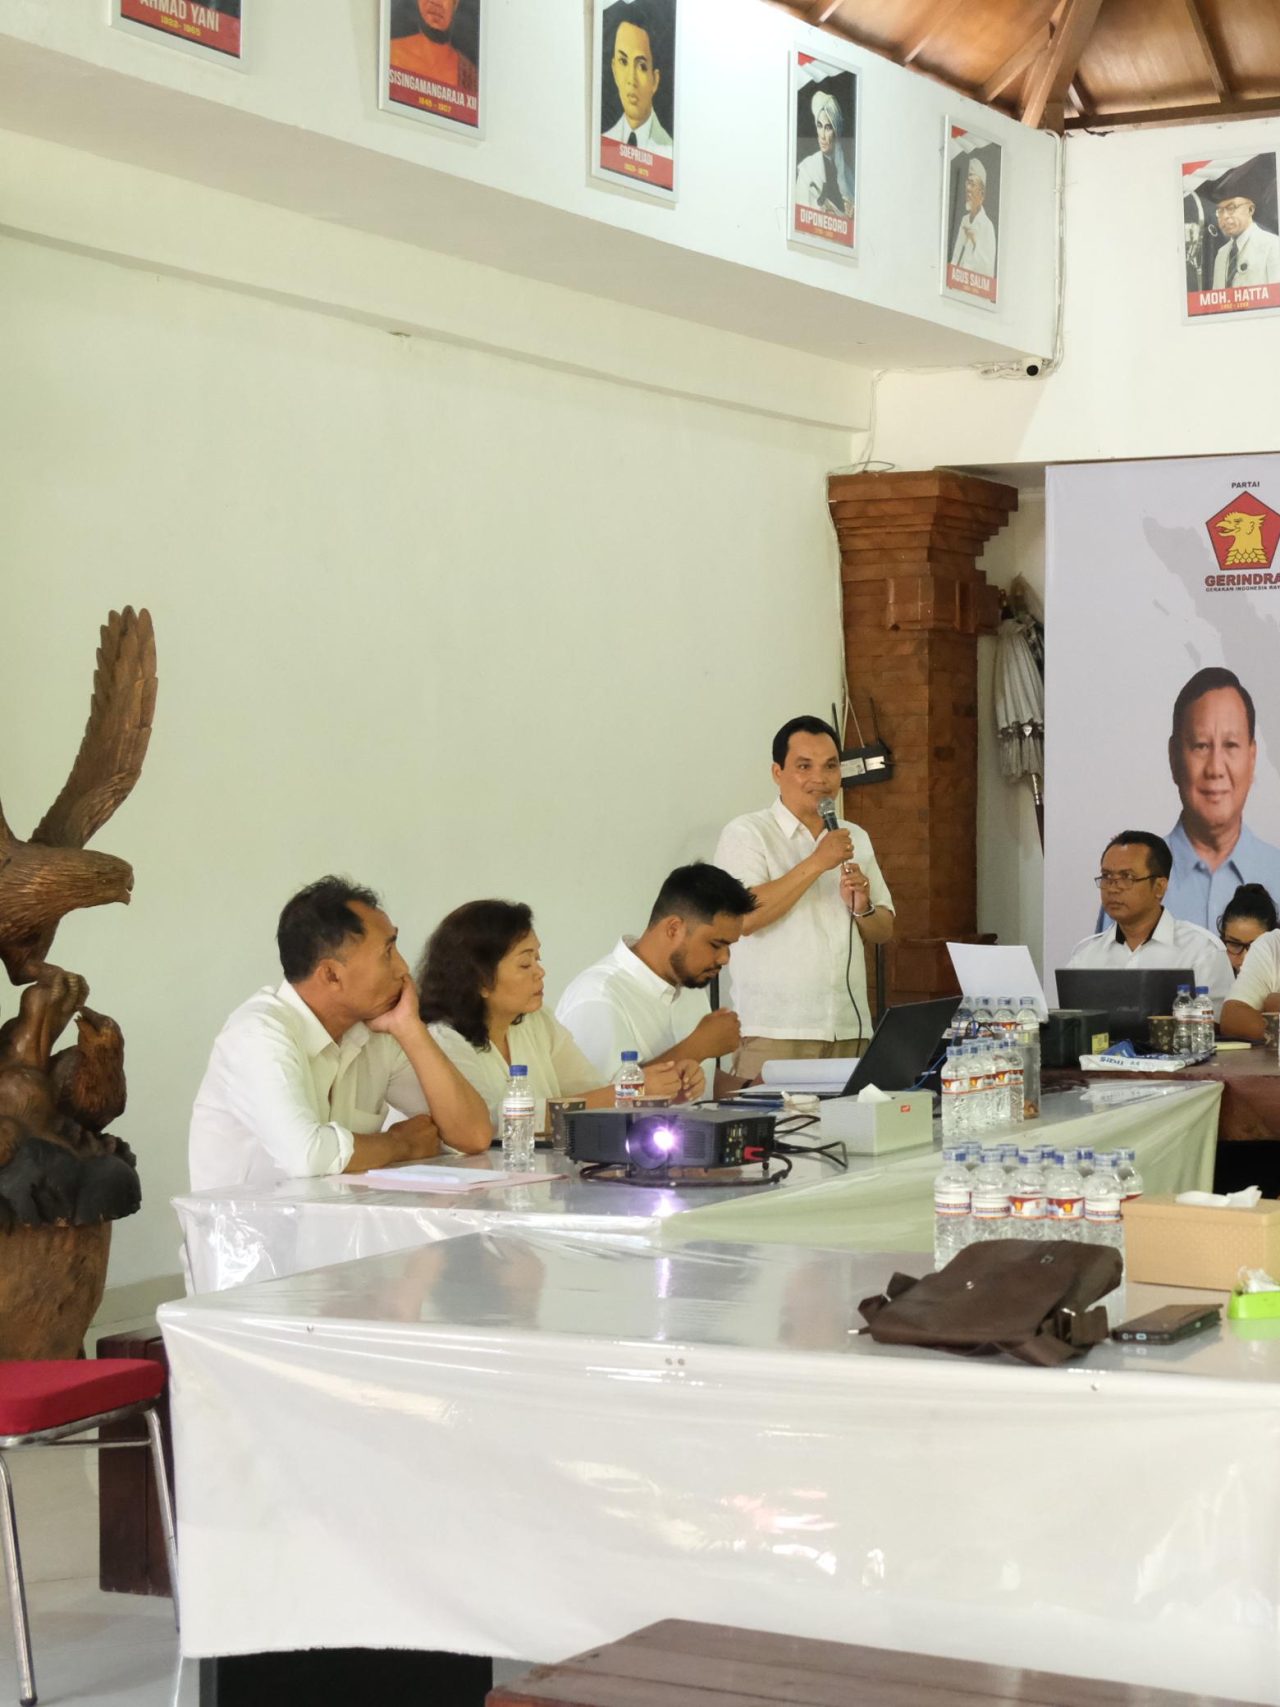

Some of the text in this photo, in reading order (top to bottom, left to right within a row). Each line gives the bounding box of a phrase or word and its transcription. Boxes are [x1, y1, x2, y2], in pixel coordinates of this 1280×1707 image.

[190, 3, 219, 32] YANI
[800, 208, 848, 235] DIPONEGORO
[1200, 287, 1269, 306] MOH. HATTA
[1231, 481, 1260, 489] PARTAI
